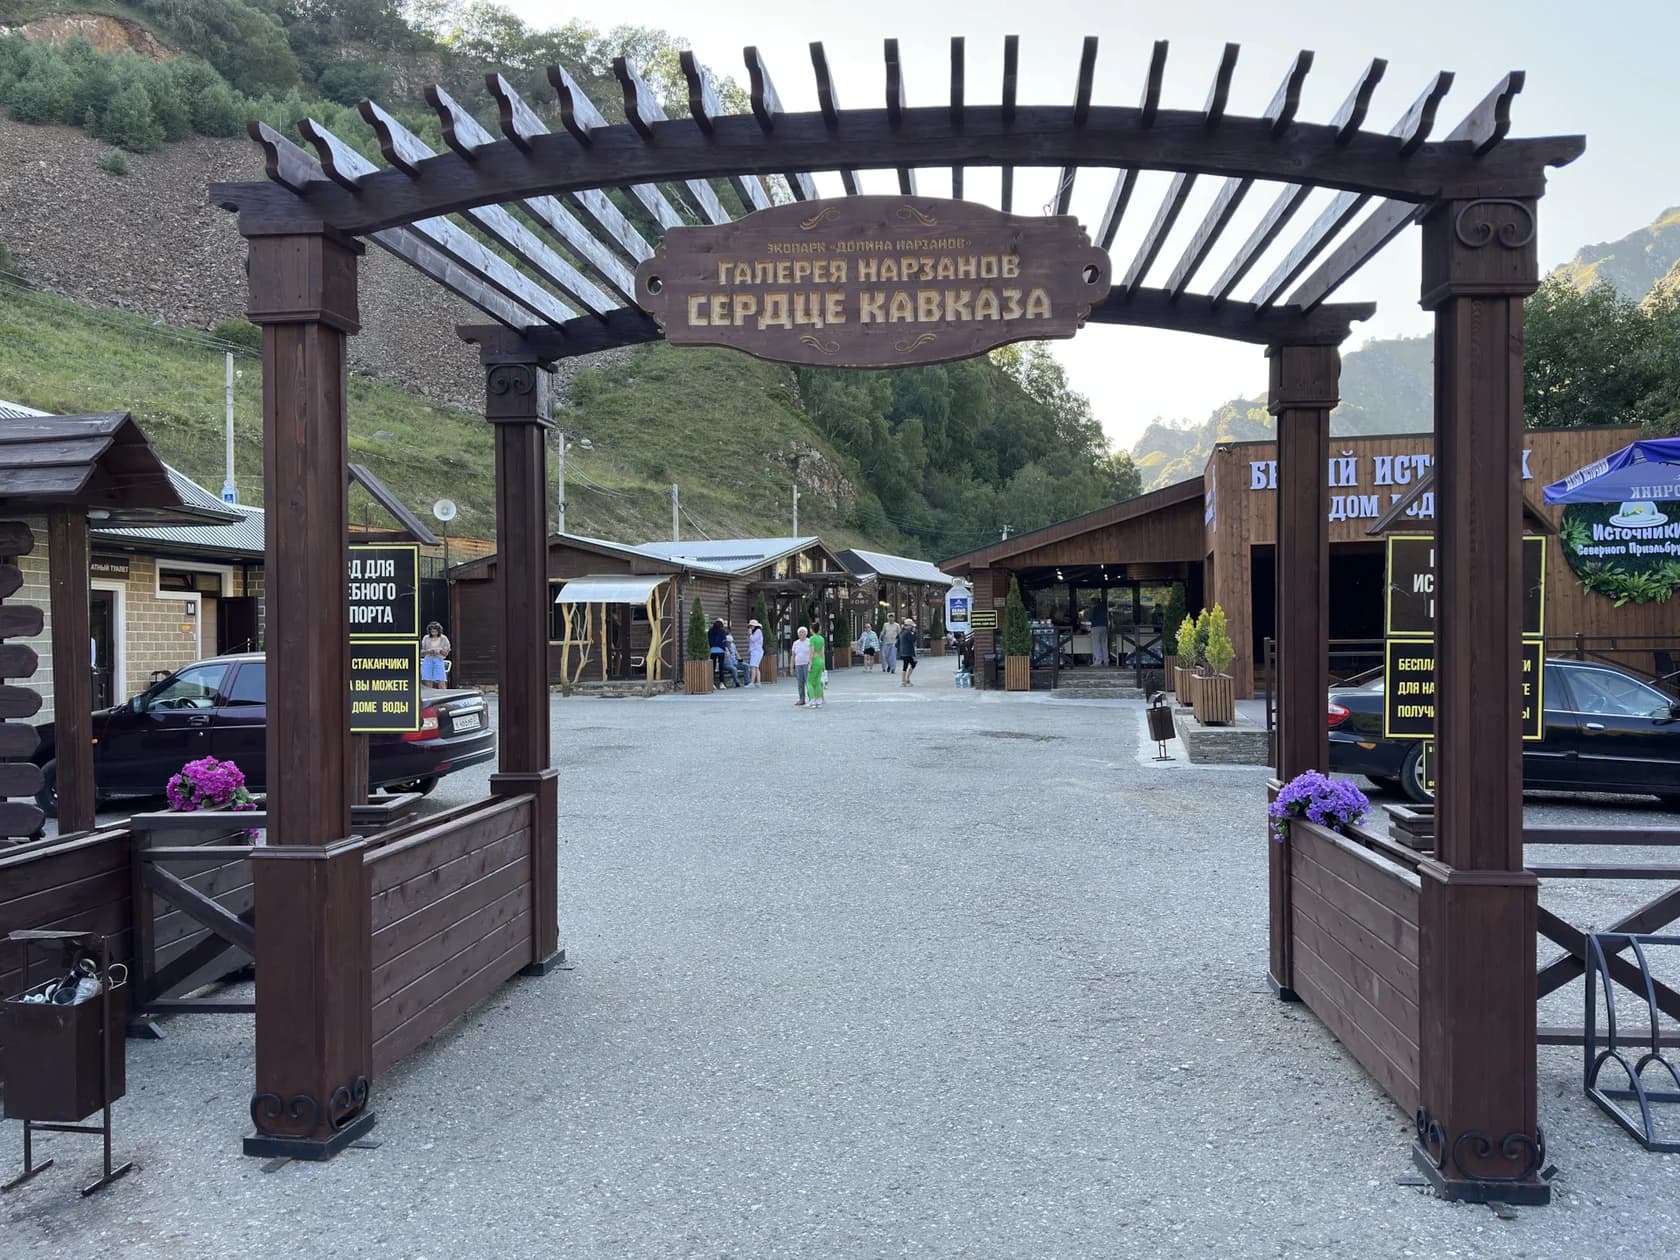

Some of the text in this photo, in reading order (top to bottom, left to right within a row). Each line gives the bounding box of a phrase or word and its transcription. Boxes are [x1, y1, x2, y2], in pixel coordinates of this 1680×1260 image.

[767, 241, 826, 254] ЭКОПАРК
[717, 254, 1020, 285] ГАЛЕРЕЯ НАРЗАНОВ
[687, 287, 1052, 330] СЕРДЦЕ КАВКАЗА
[1328, 494, 1379, 522] ДОМ
[1577, 544, 1626, 558] Северного
[364, 559, 395, 578] ДЛЯ
[348, 583, 396, 600] БНОГО
[349, 606, 393, 624] ПОРТА
[351, 658, 409, 670] СТАКАНЧИКИ
[1398, 658, 1435, 671] БЕСПЛ
[355, 680, 370, 691] ВЫ
[371, 679, 409, 691] МОЖЕТЕ
[1397, 682, 1419, 696] ДЛЯ
[352, 701, 409, 714] ДОМЕ ВОДЫ
[1397, 705, 1435, 718] ПОЛУЧ
